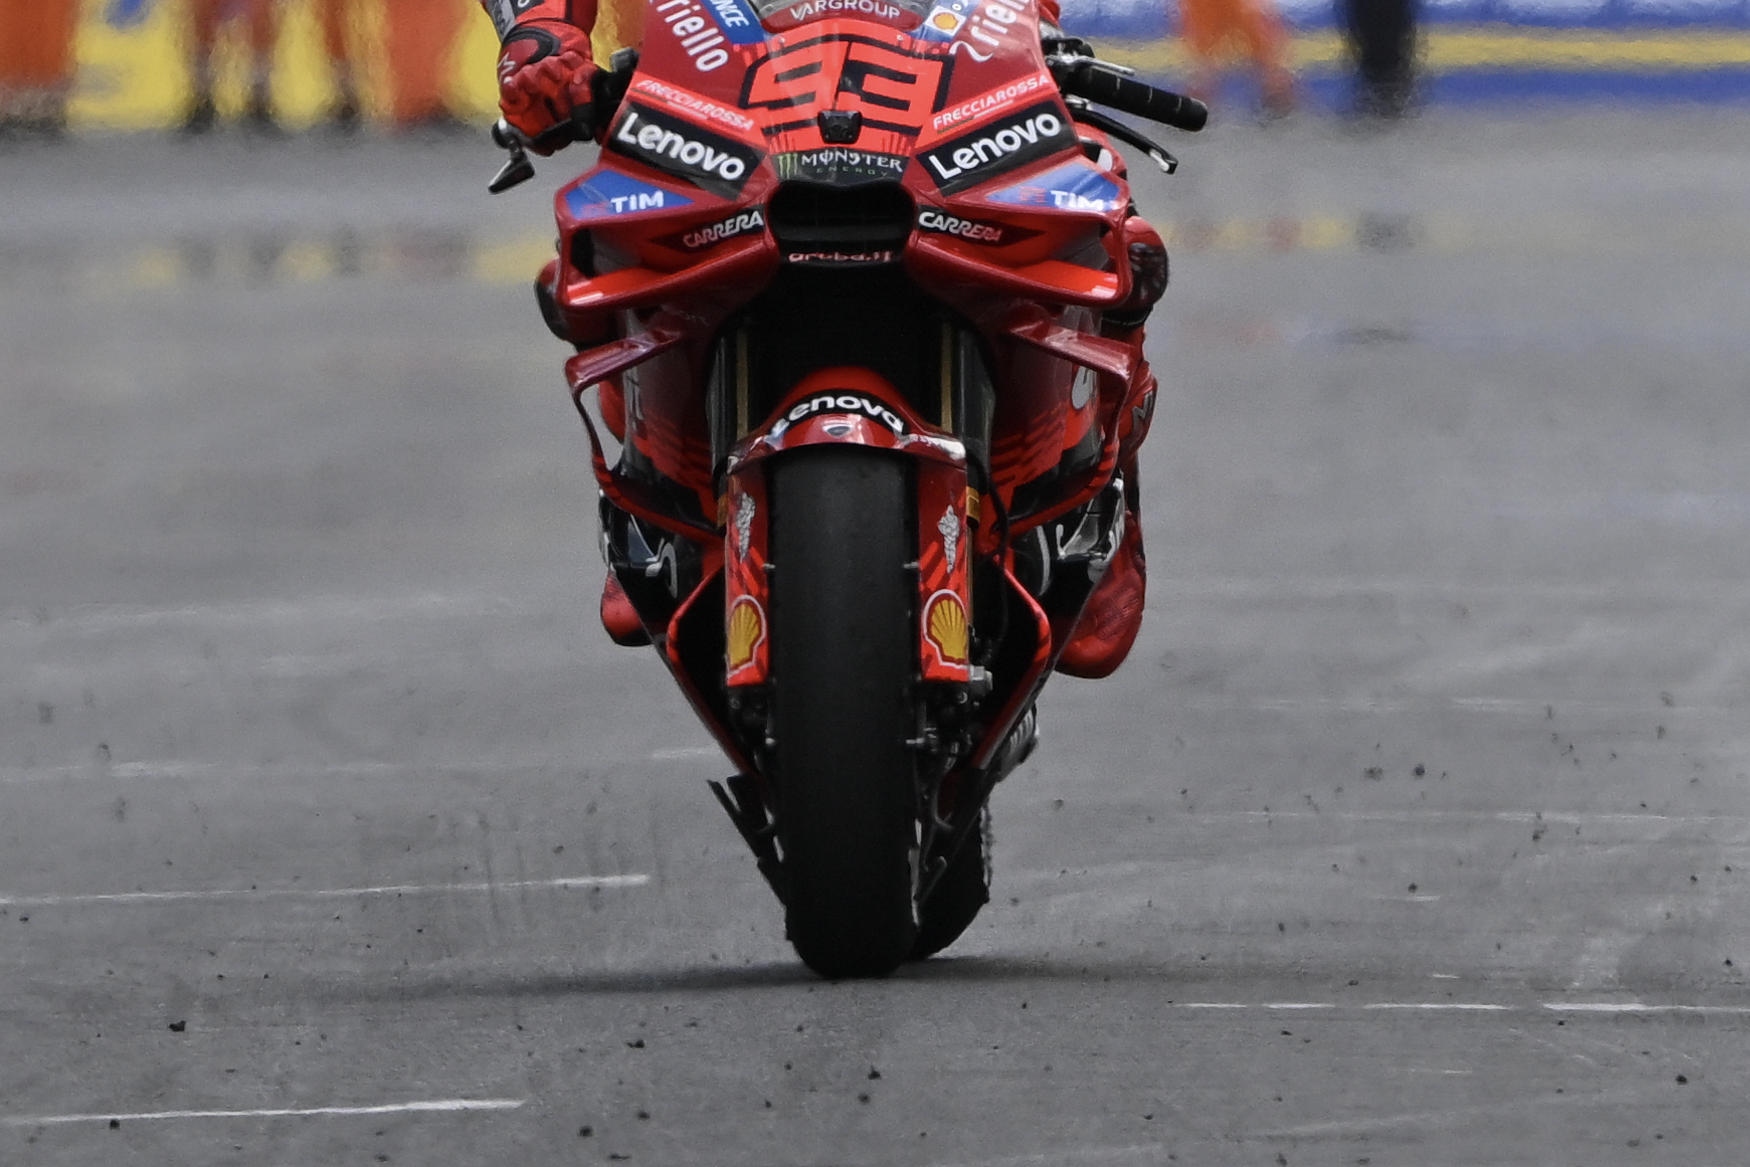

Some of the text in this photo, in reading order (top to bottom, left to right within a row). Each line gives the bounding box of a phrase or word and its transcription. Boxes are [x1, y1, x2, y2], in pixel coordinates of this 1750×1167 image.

[635, 79, 754, 130] FRECCIAROSSA
[933, 74, 1050, 130] FRECCIAROSSA
[616, 112, 745, 181] Lenovo
[801, 148, 903, 173] MONSTER
[928, 113, 1061, 180] Lenovo
[816, 165, 889, 177] ENERGY
[610, 190, 665, 214] TIM
[1050, 189, 1105, 211] TIM
[683, 210, 765, 248] CARRERA
[918, 211, 1002, 242] CARRERA
[788, 249, 893, 262] aruba.it
